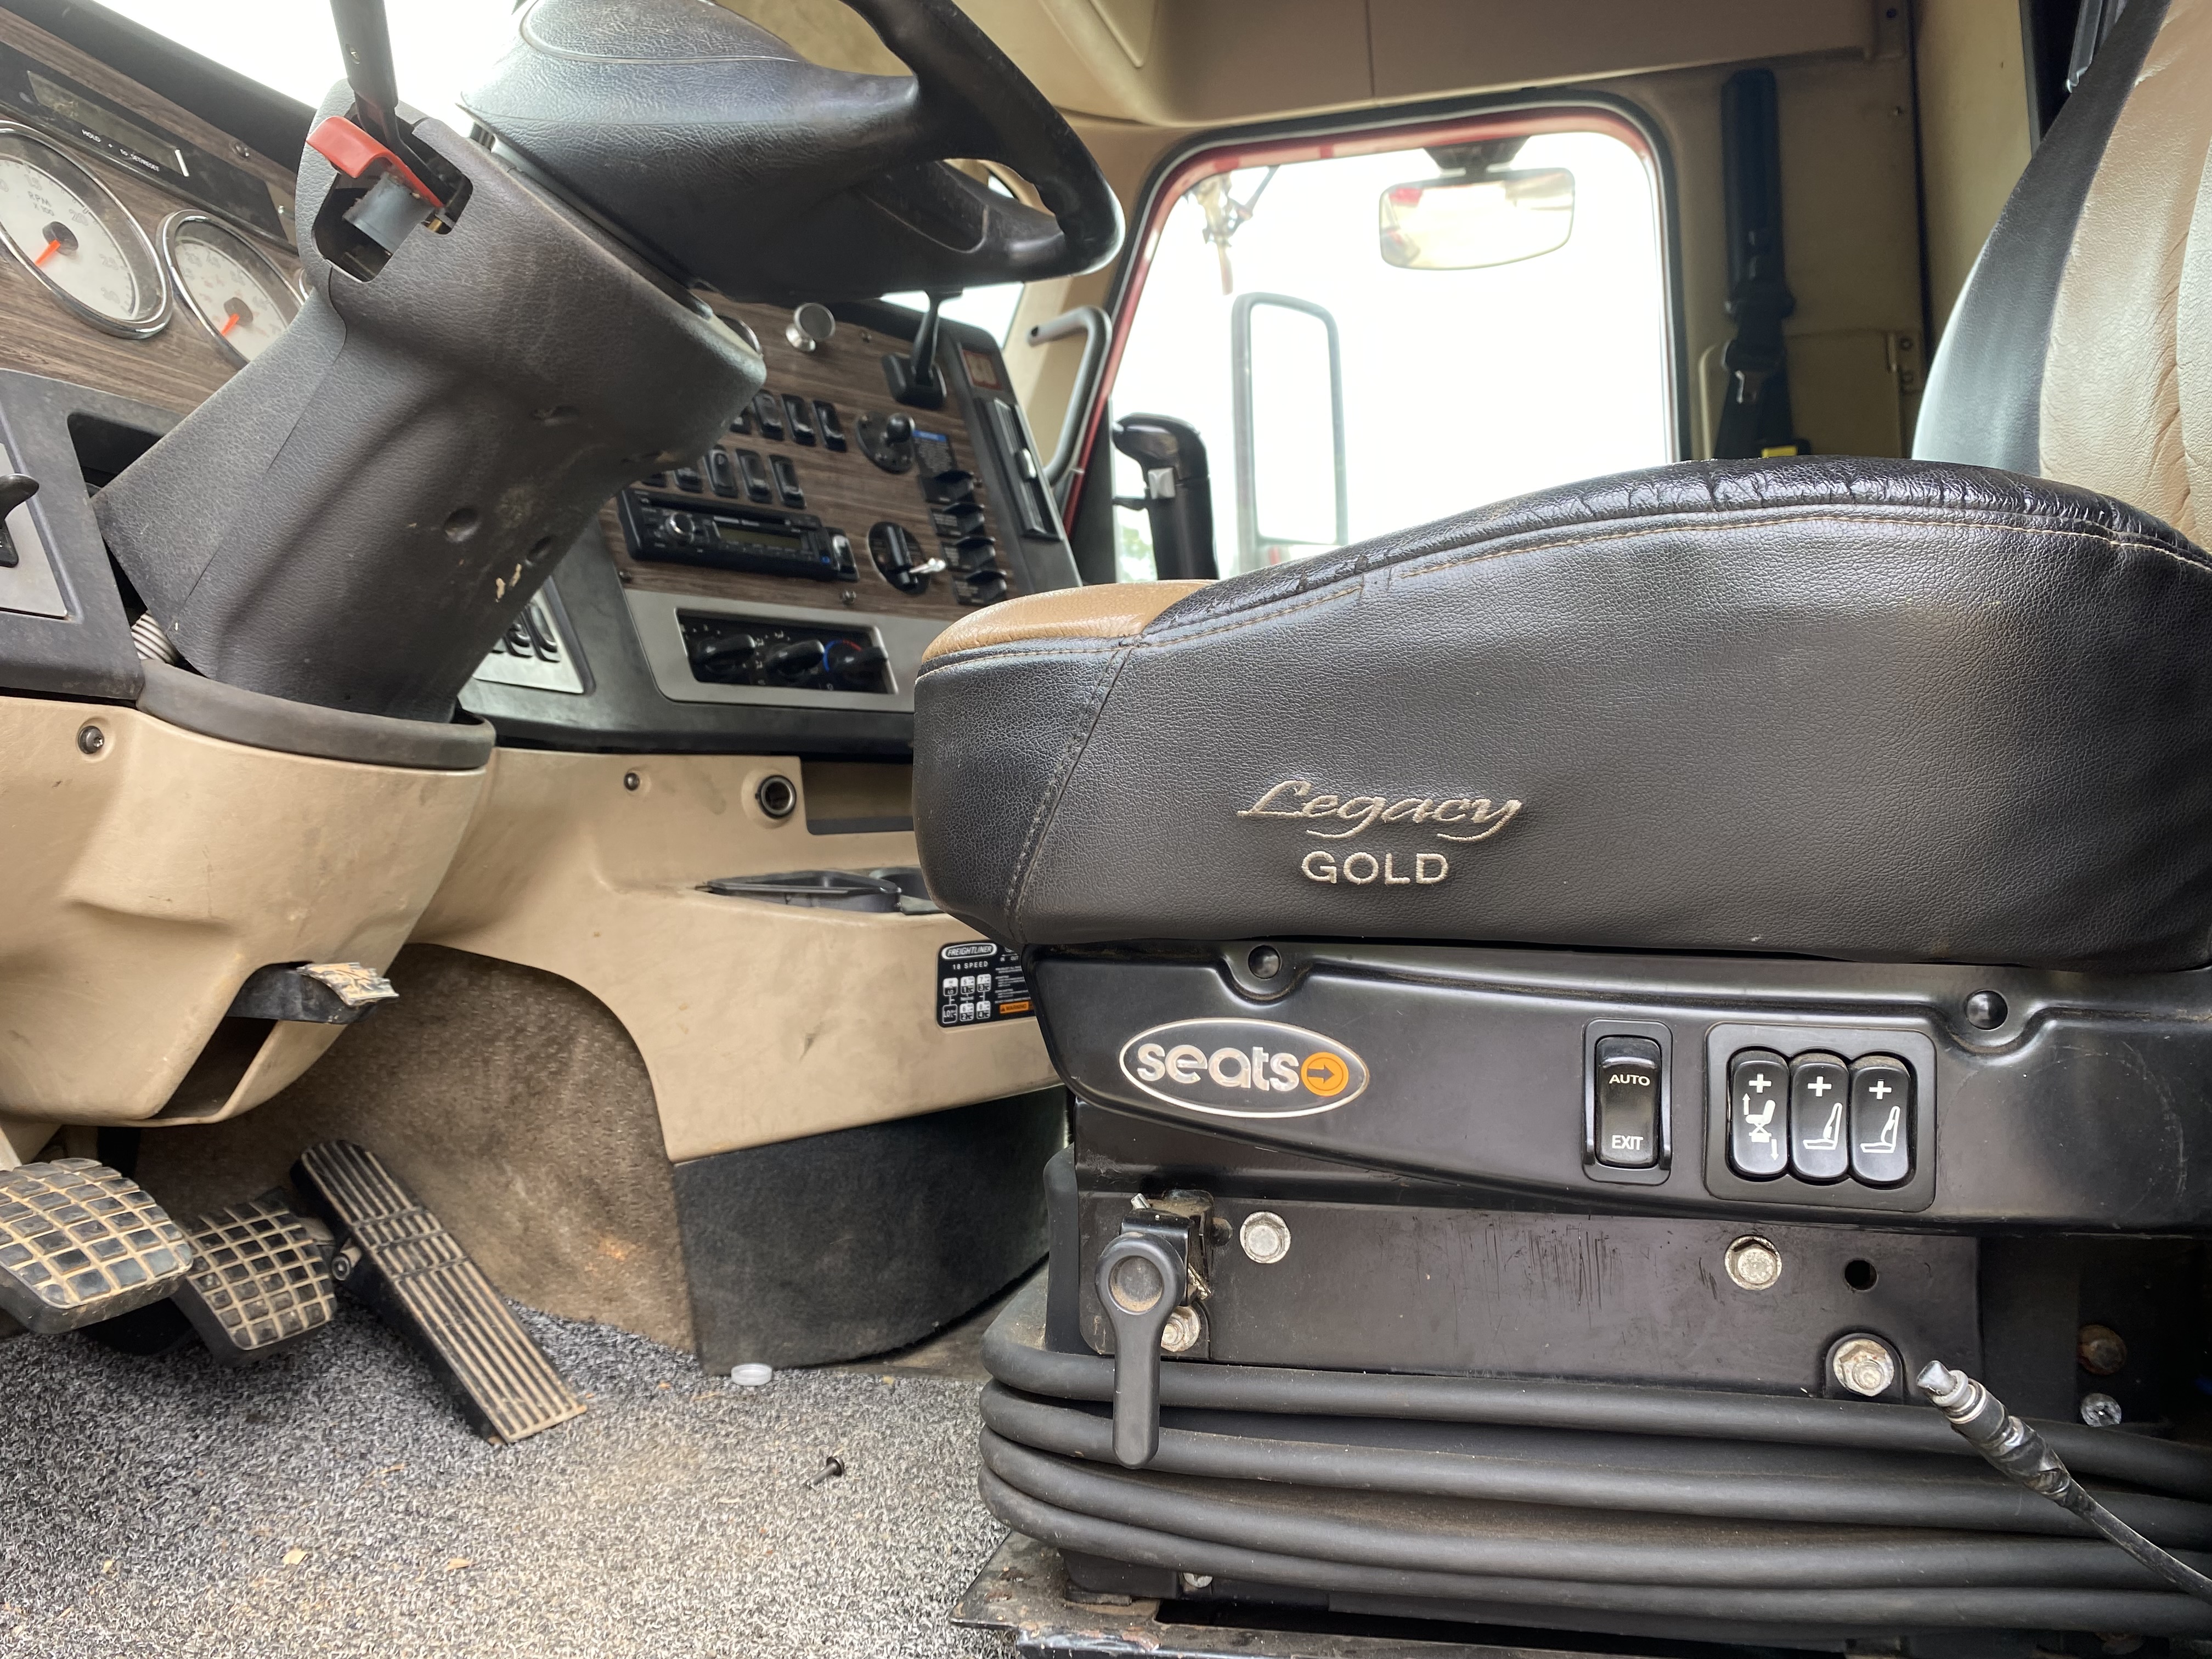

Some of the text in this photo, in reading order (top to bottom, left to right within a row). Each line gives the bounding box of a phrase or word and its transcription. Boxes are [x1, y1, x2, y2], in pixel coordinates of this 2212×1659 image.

[82, 129, 101, 143] HOLD
[28, 191, 52, 207] RPM
[69, 208, 89, 226] 20
[1236, 778, 1523, 843] Legacy
[1301, 851, 1449, 885] GOLD
[947, 946, 992, 957] FREIGHTLINER
[964, 961, 989, 969] SPEED
[1137, 1042, 1300, 1092] seats
[1609, 1073, 1650, 1087] AUTO
[1611, 1134, 1644, 1151] EXIT
